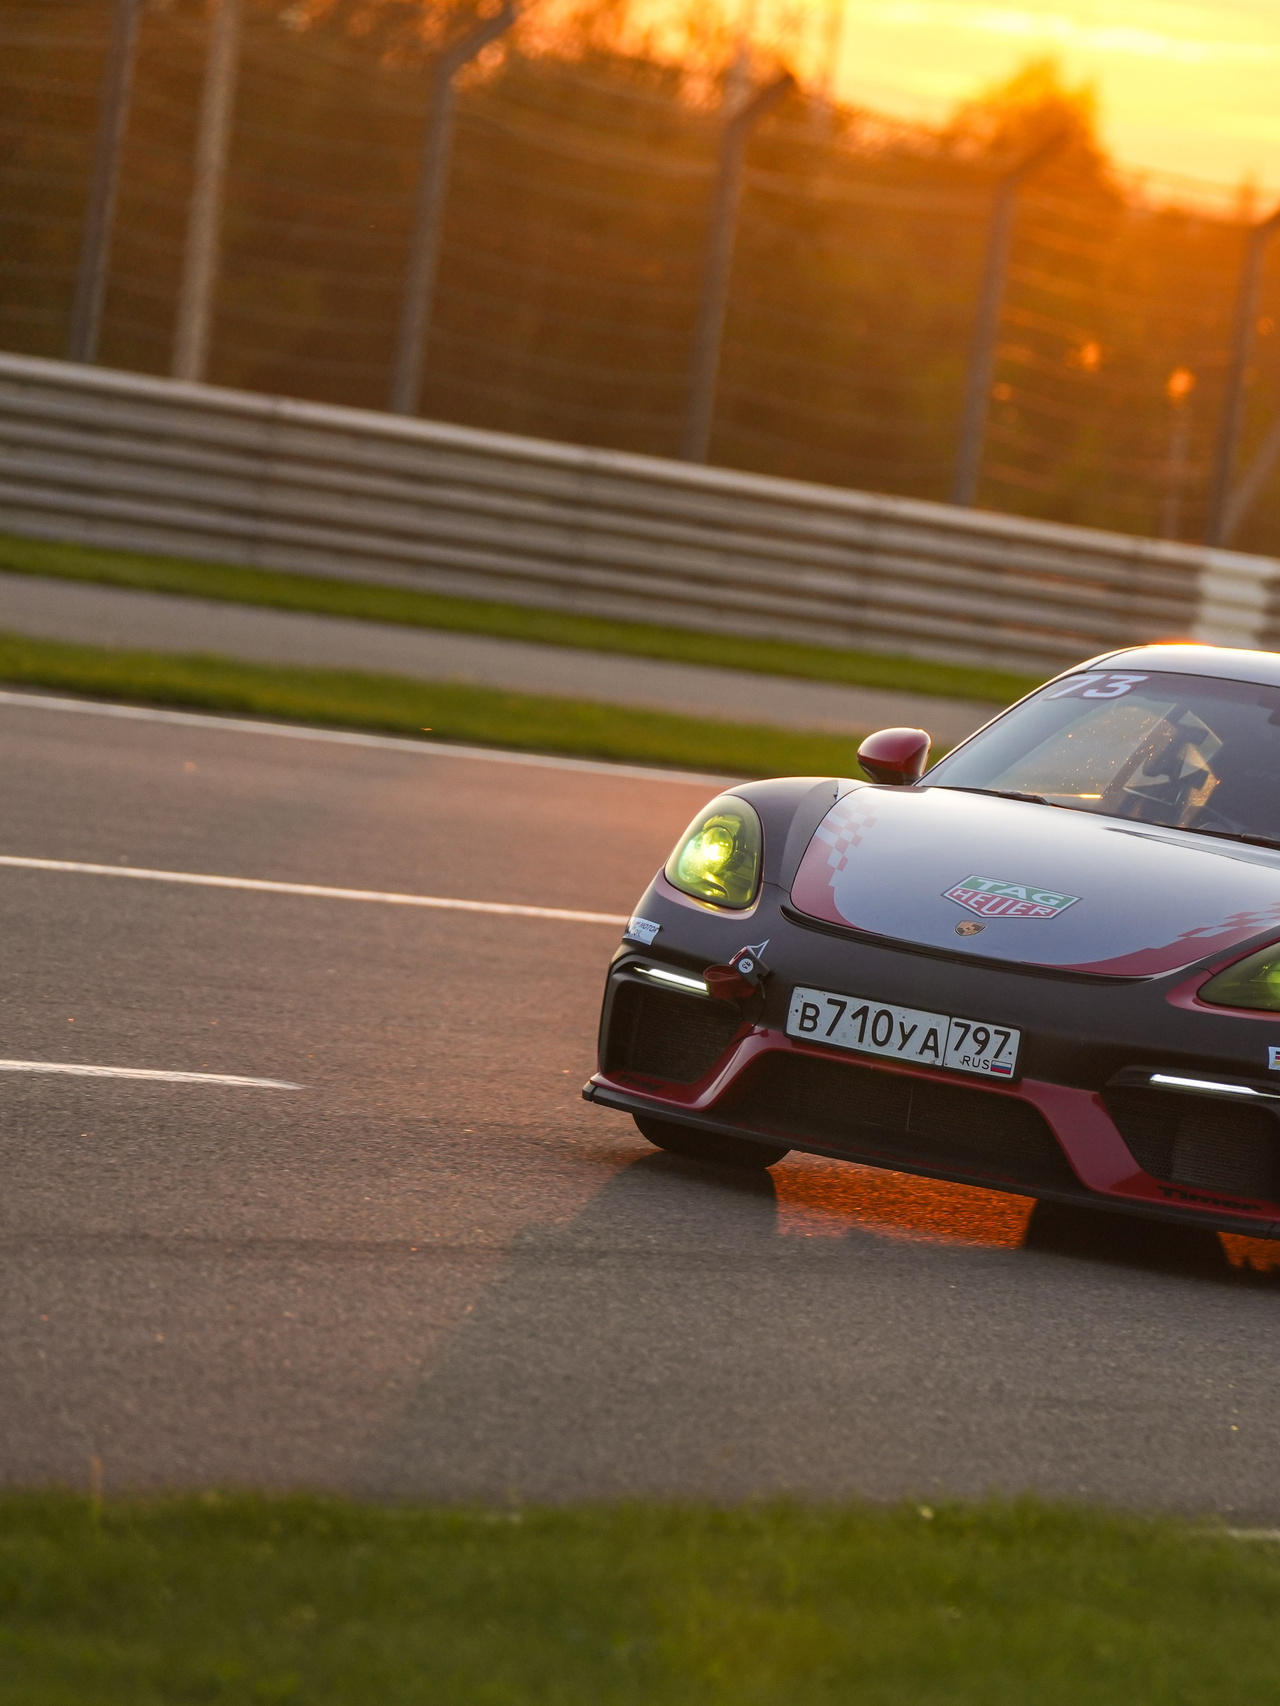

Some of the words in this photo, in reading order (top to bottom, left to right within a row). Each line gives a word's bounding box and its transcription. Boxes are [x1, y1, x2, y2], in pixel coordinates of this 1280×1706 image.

[1046, 674, 1149, 698] 73
[952, 889, 1053, 916] HEUER
[976, 878, 1065, 906] TAG
[798, 998, 940, 1059] В710УА
[953, 1022, 1012, 1059] 797
[962, 1055, 990, 1070] RUS
